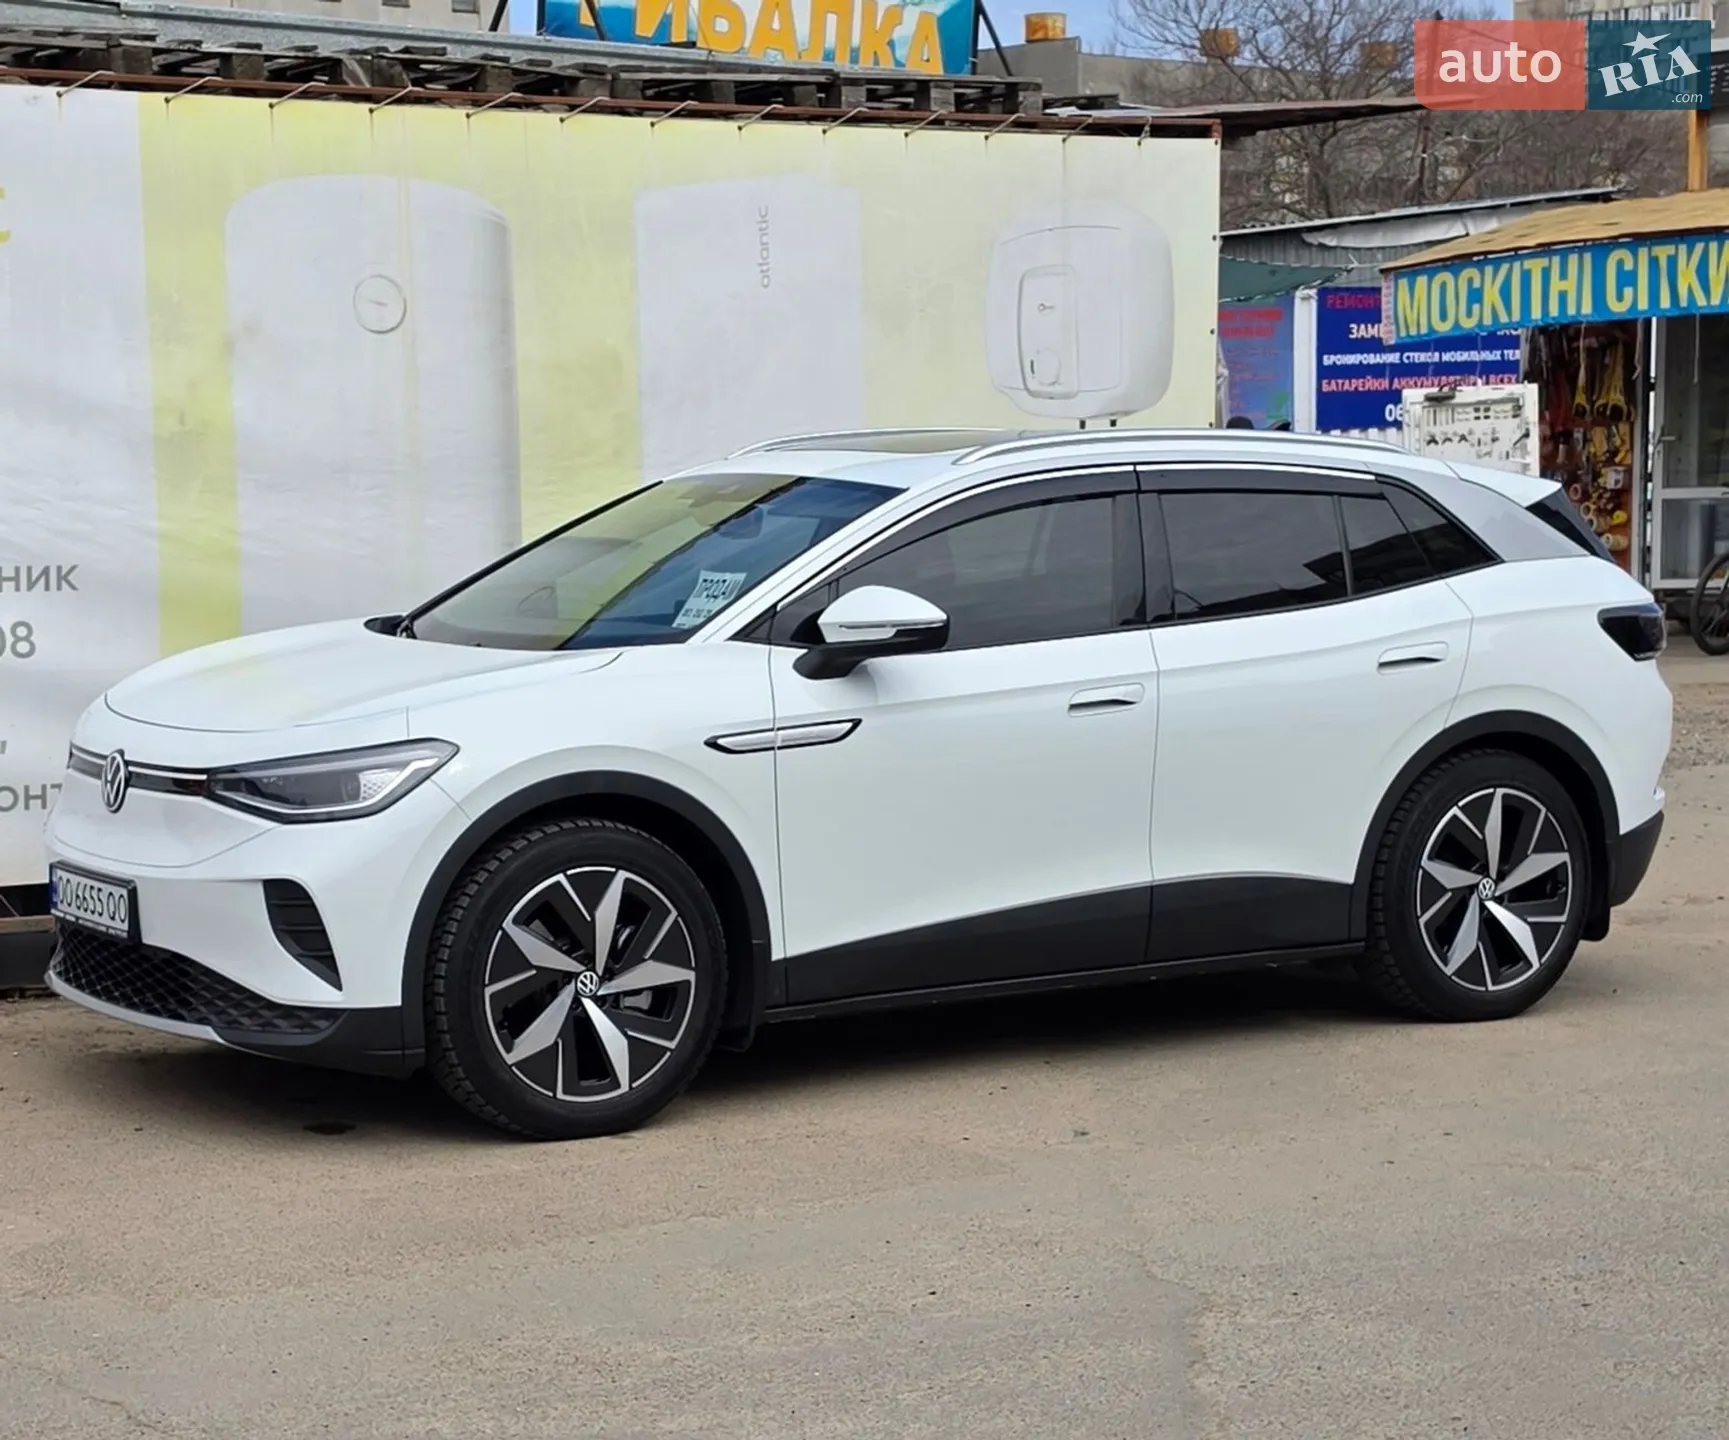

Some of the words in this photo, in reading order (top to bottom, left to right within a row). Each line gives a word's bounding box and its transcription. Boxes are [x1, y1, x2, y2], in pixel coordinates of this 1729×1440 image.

[578, 0, 945, 75] ИБАЛКА
[756, 204, 771, 289] atlantic
[1398, 252, 1593, 338] МОСКІТНІ
[1606, 240, 1729, 313] СІТКИ
[1321, 376, 1389, 392] БАТАРЕЙКИ
[1323, 352, 1401, 366] БРОНИРОВАНИЕ
[1402, 351, 1440, 364] СТЕКОЛ
[1441, 349, 1502, 363] МОБИЛЬНЫХ
[75, 881, 104, 918] 6655
